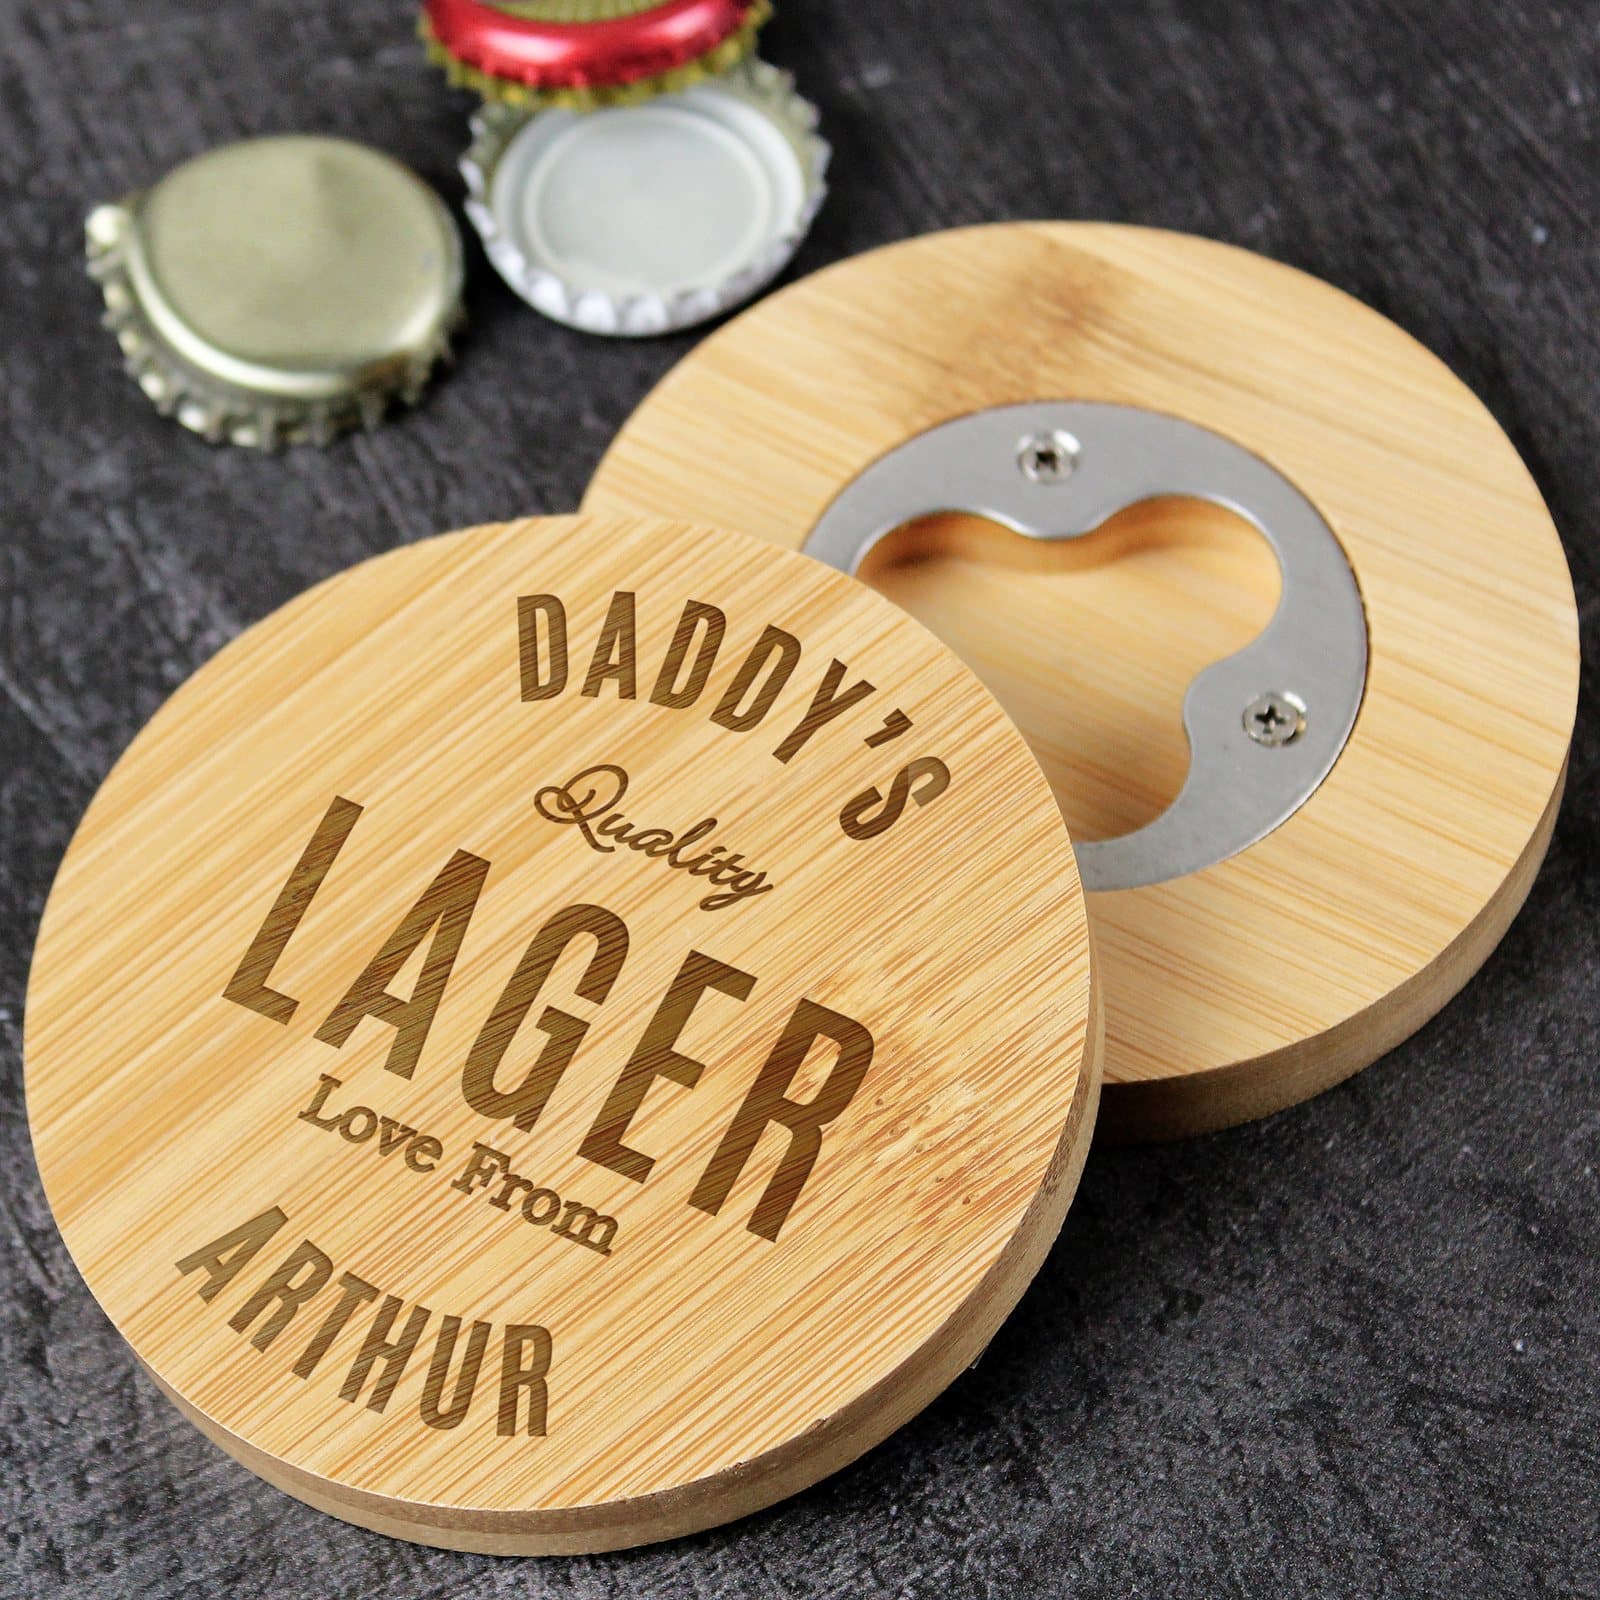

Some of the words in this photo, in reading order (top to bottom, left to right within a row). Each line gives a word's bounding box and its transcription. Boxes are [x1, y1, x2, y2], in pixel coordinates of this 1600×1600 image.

[517, 590, 951, 841] DADDY'S
[533, 764, 774, 910] Quality
[222, 795, 875, 1243] LAGER
[298, 1073, 443, 1173] Love
[452, 1141, 618, 1255] From
[175, 1206, 553, 1438] ARTHUR
